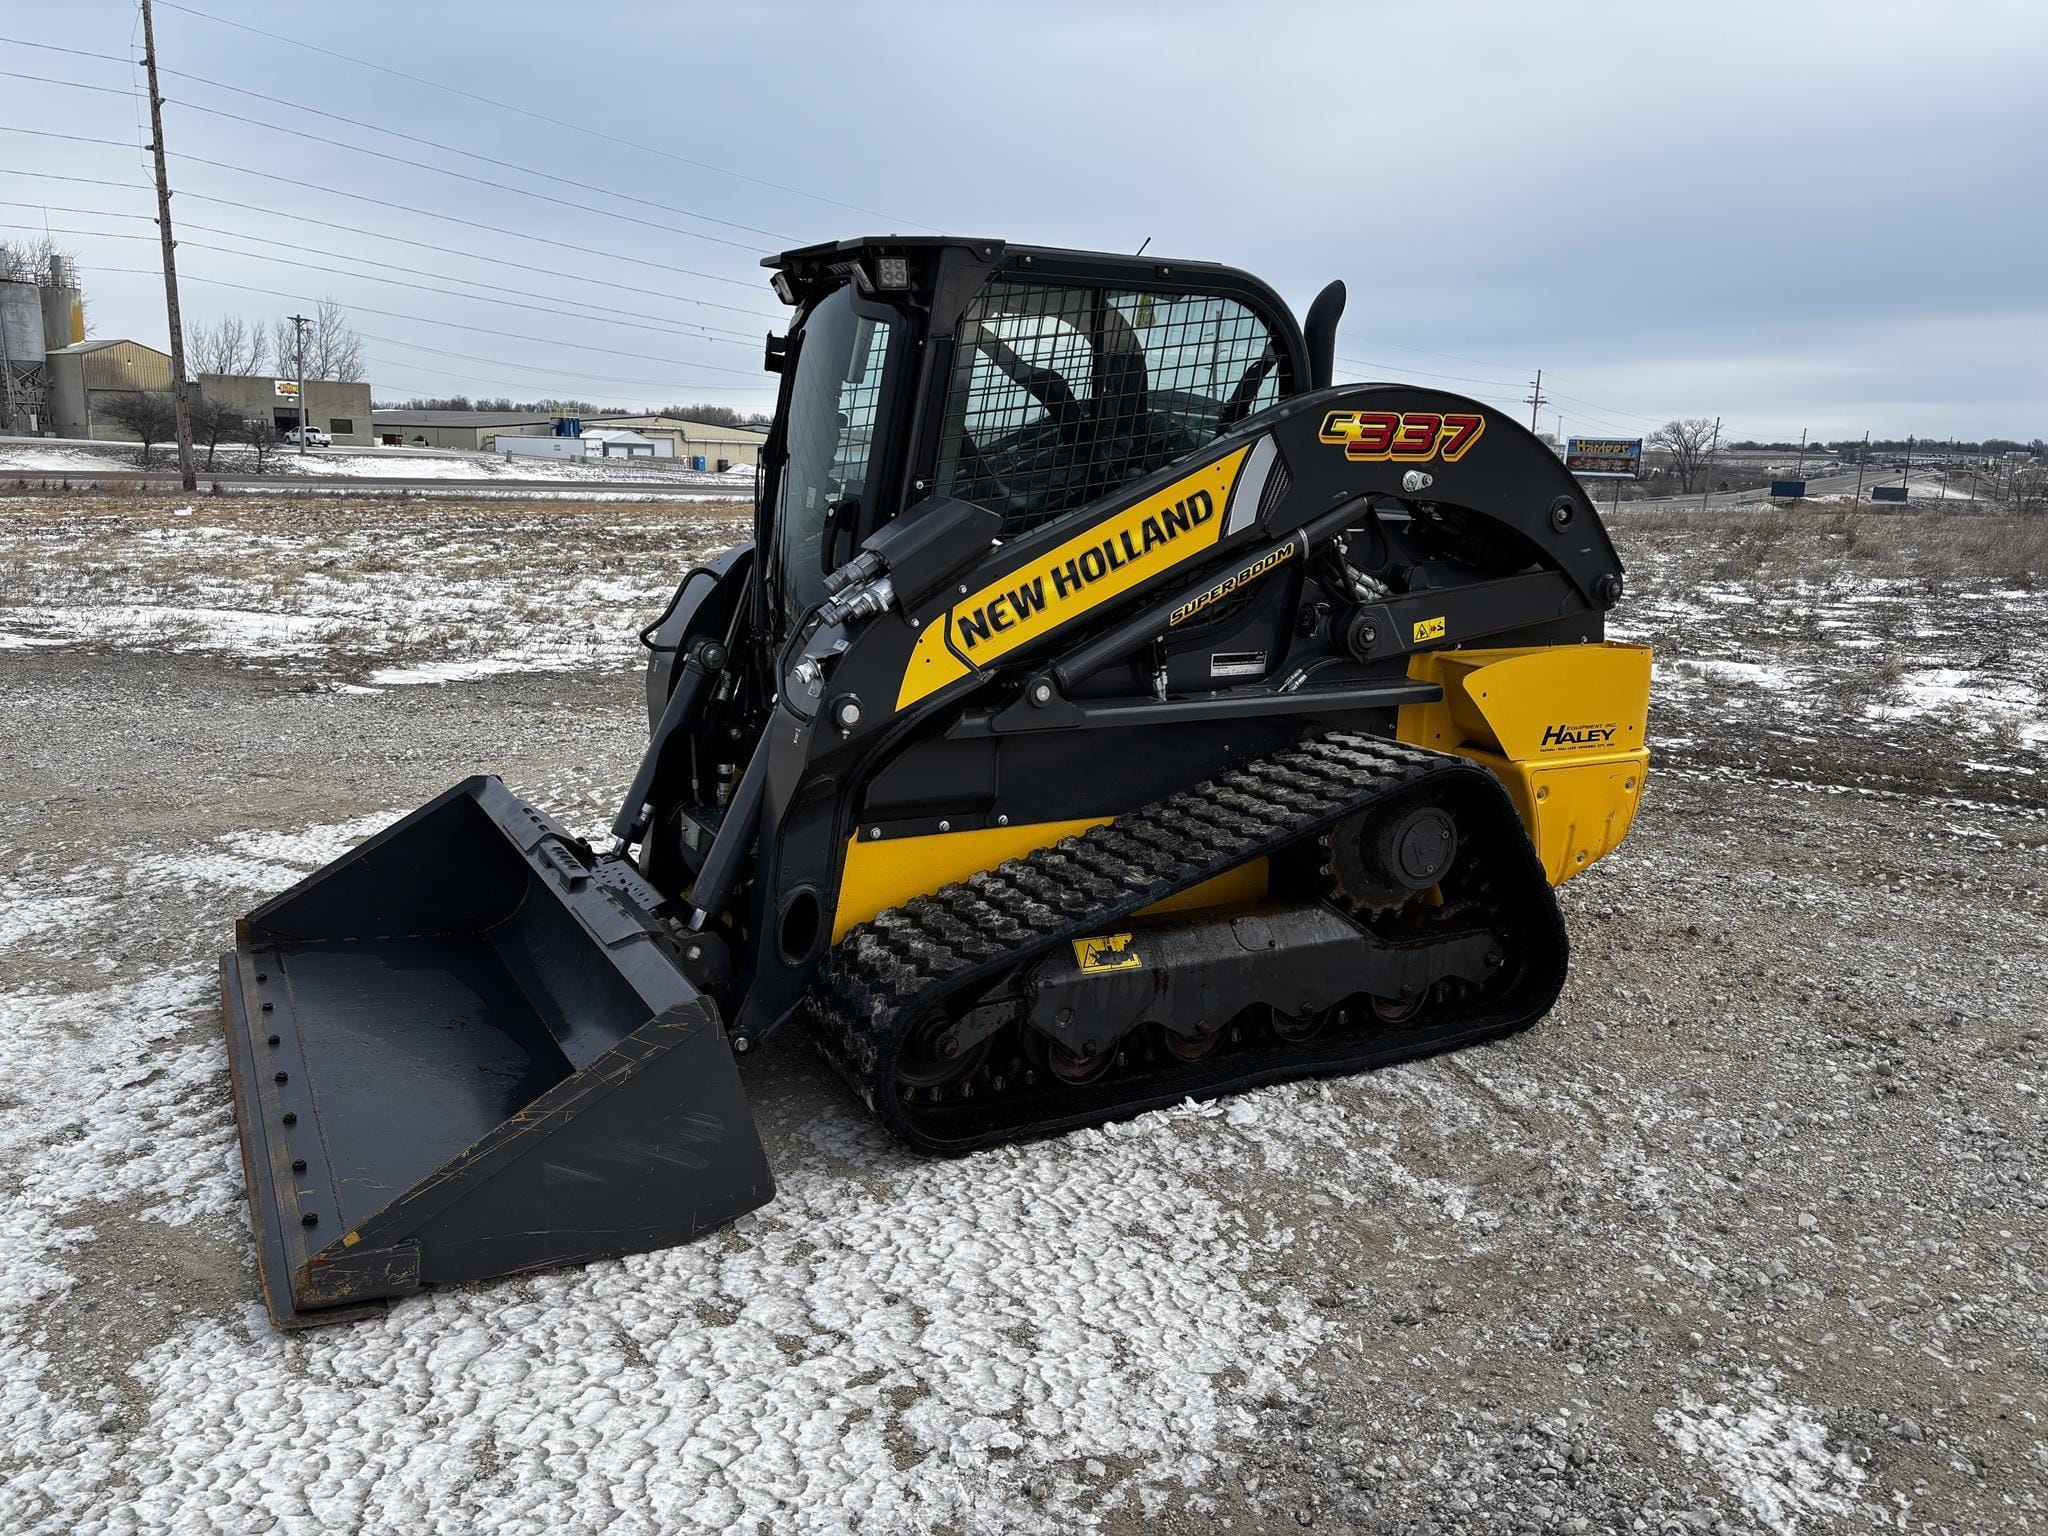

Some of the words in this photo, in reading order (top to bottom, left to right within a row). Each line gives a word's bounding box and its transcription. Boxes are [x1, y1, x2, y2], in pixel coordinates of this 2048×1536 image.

[1319, 410, 1486, 462] C337
[957, 576, 1047, 649] NEW
[1051, 489, 1213, 600] HOLLAND
[1170, 577, 1237, 626] SUPER
[1237, 542, 1295, 586] BOOM
[1541, 725, 1616, 746] HALEY
